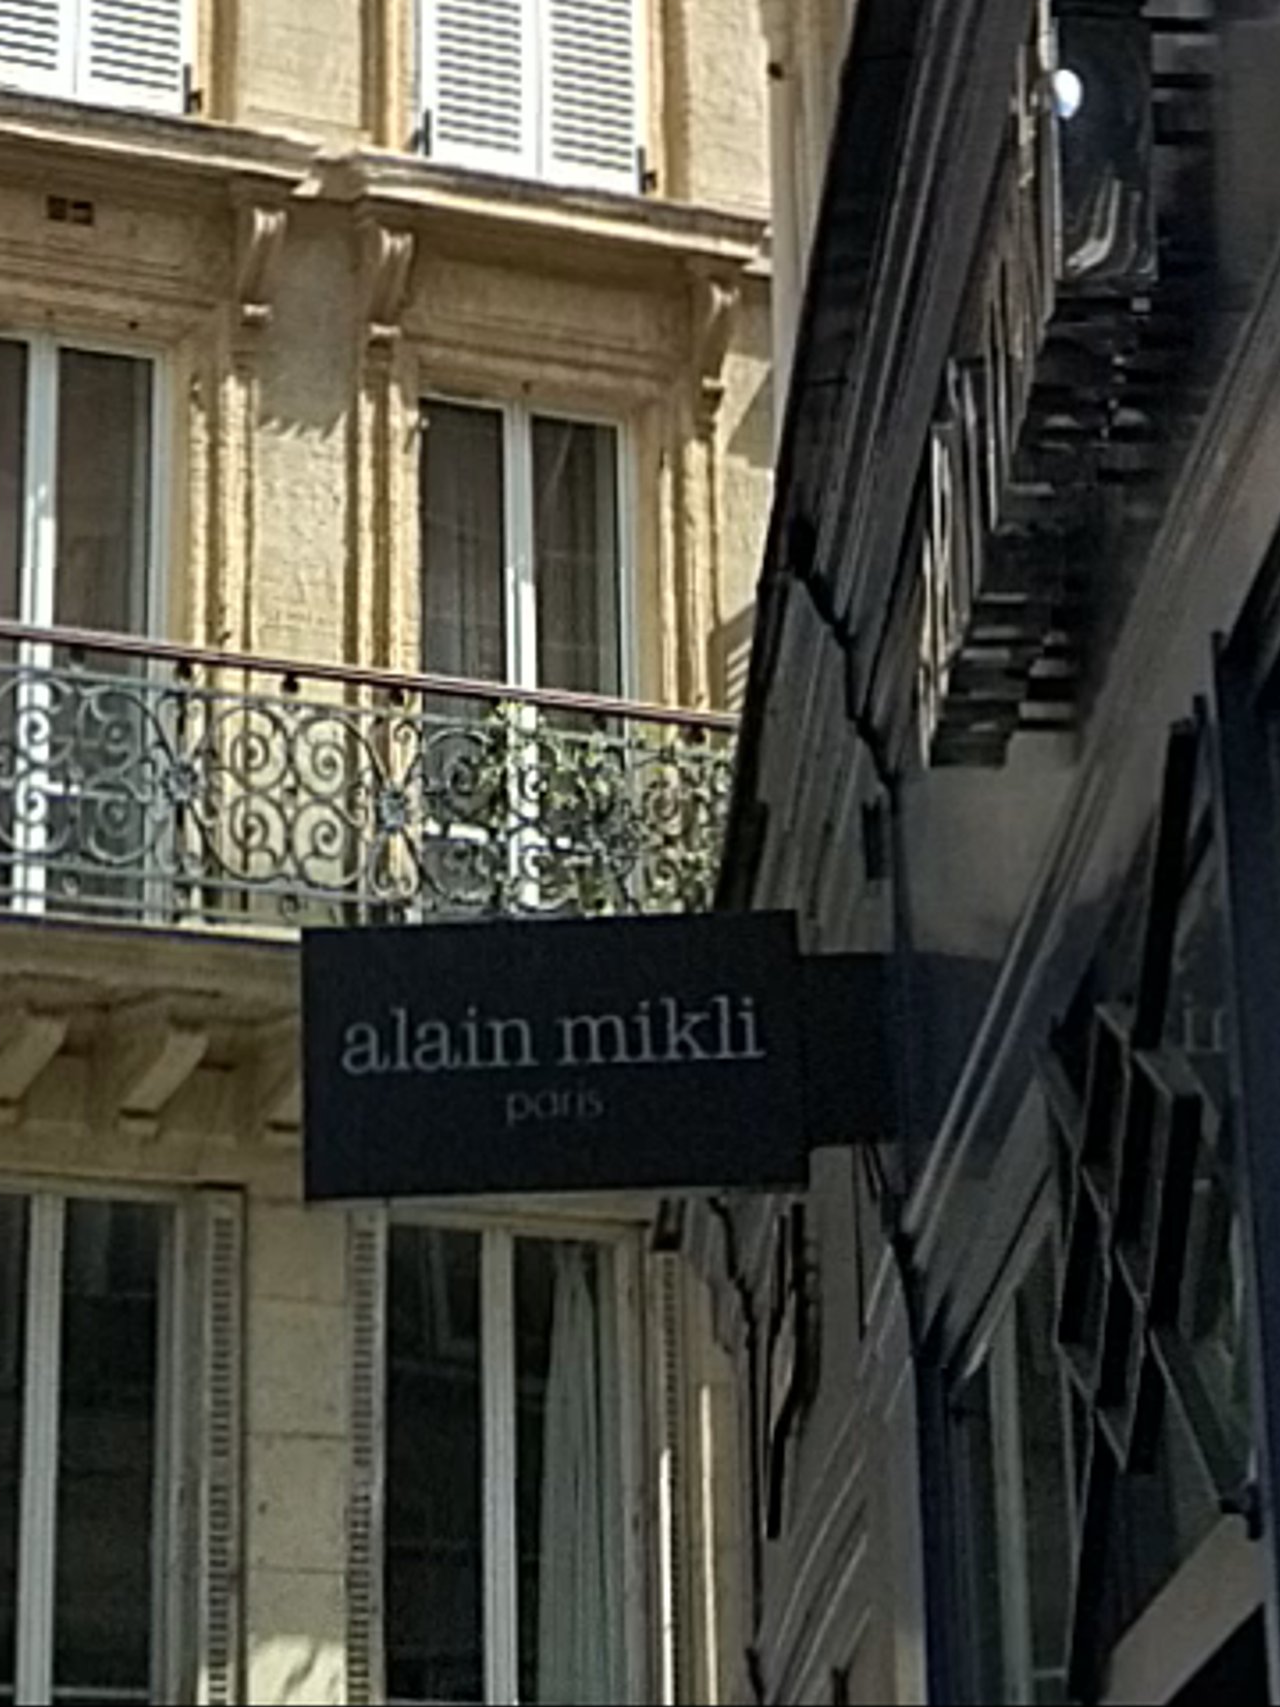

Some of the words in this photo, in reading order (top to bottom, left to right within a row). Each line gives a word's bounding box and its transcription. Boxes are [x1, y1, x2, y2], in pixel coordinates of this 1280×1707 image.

[340, 1005, 539, 1075] alain
[555, 994, 766, 1067] mikli
[506, 1085, 604, 1127] paris
